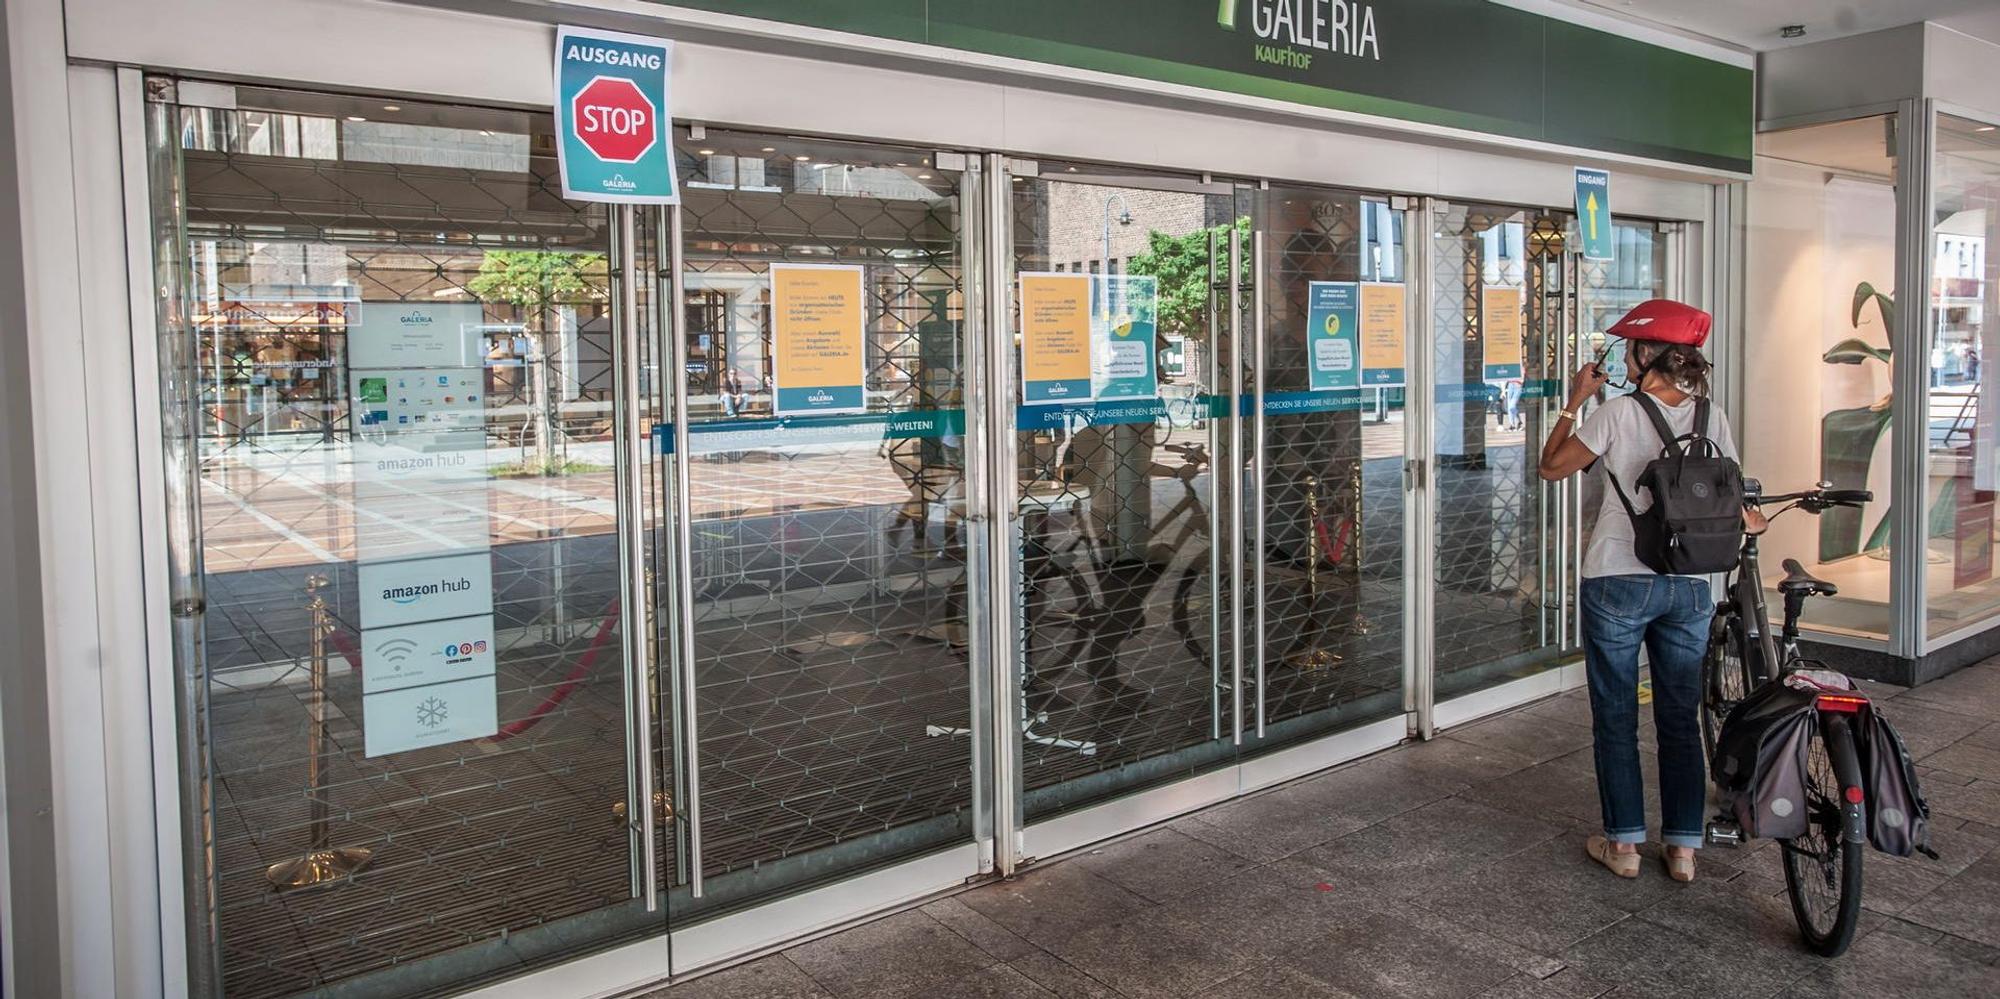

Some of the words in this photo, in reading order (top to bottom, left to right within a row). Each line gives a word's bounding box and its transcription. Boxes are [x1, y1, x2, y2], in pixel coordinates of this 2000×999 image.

[1252, 0, 1380, 60] GALERIA
[567, 45, 661, 70] AUSGANG
[583, 104, 646, 136] STOP
[602, 179, 637, 189] GALERIA
[1578, 174, 1606, 187] EINGANG
[400, 315, 433, 324] GALERIA
[1098, 409, 1125, 419] UNSERE
[1125, 407, 1149, 417] NEUEN
[377, 457, 433, 471] amazon
[436, 452, 466, 466] hub
[383, 583, 438, 600] amazon
[442, 577, 471, 593] hub
